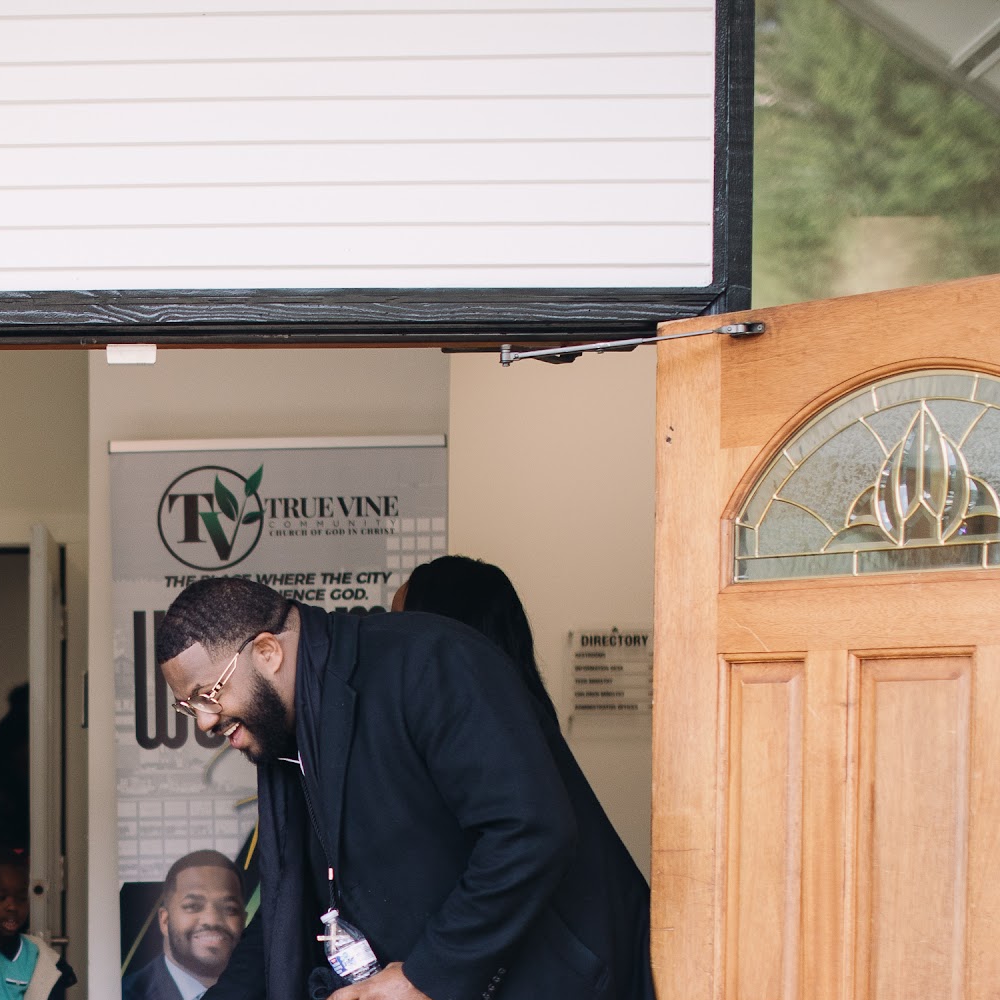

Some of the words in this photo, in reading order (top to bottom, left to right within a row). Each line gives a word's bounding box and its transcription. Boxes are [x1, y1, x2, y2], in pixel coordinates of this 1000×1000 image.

[264, 497, 334, 518] TRUE
[337, 496, 399, 517] VINE
[268, 519, 397, 528] COMMUNITY
[269, 529, 308, 537] CHURCH
[310, 529, 322, 537] OF
[325, 528, 346, 536] GOD
[348, 528, 358, 536] IN
[361, 527, 396, 536] CHRIST
[256, 573, 316, 586] WHERE
[320, 572, 353, 585] THE
[356, 571, 393, 584] CITY
[280, 588, 326, 600] IENCE
[330, 588, 369, 600] GOD.
[581, 635, 649, 647] DIRECTORY
